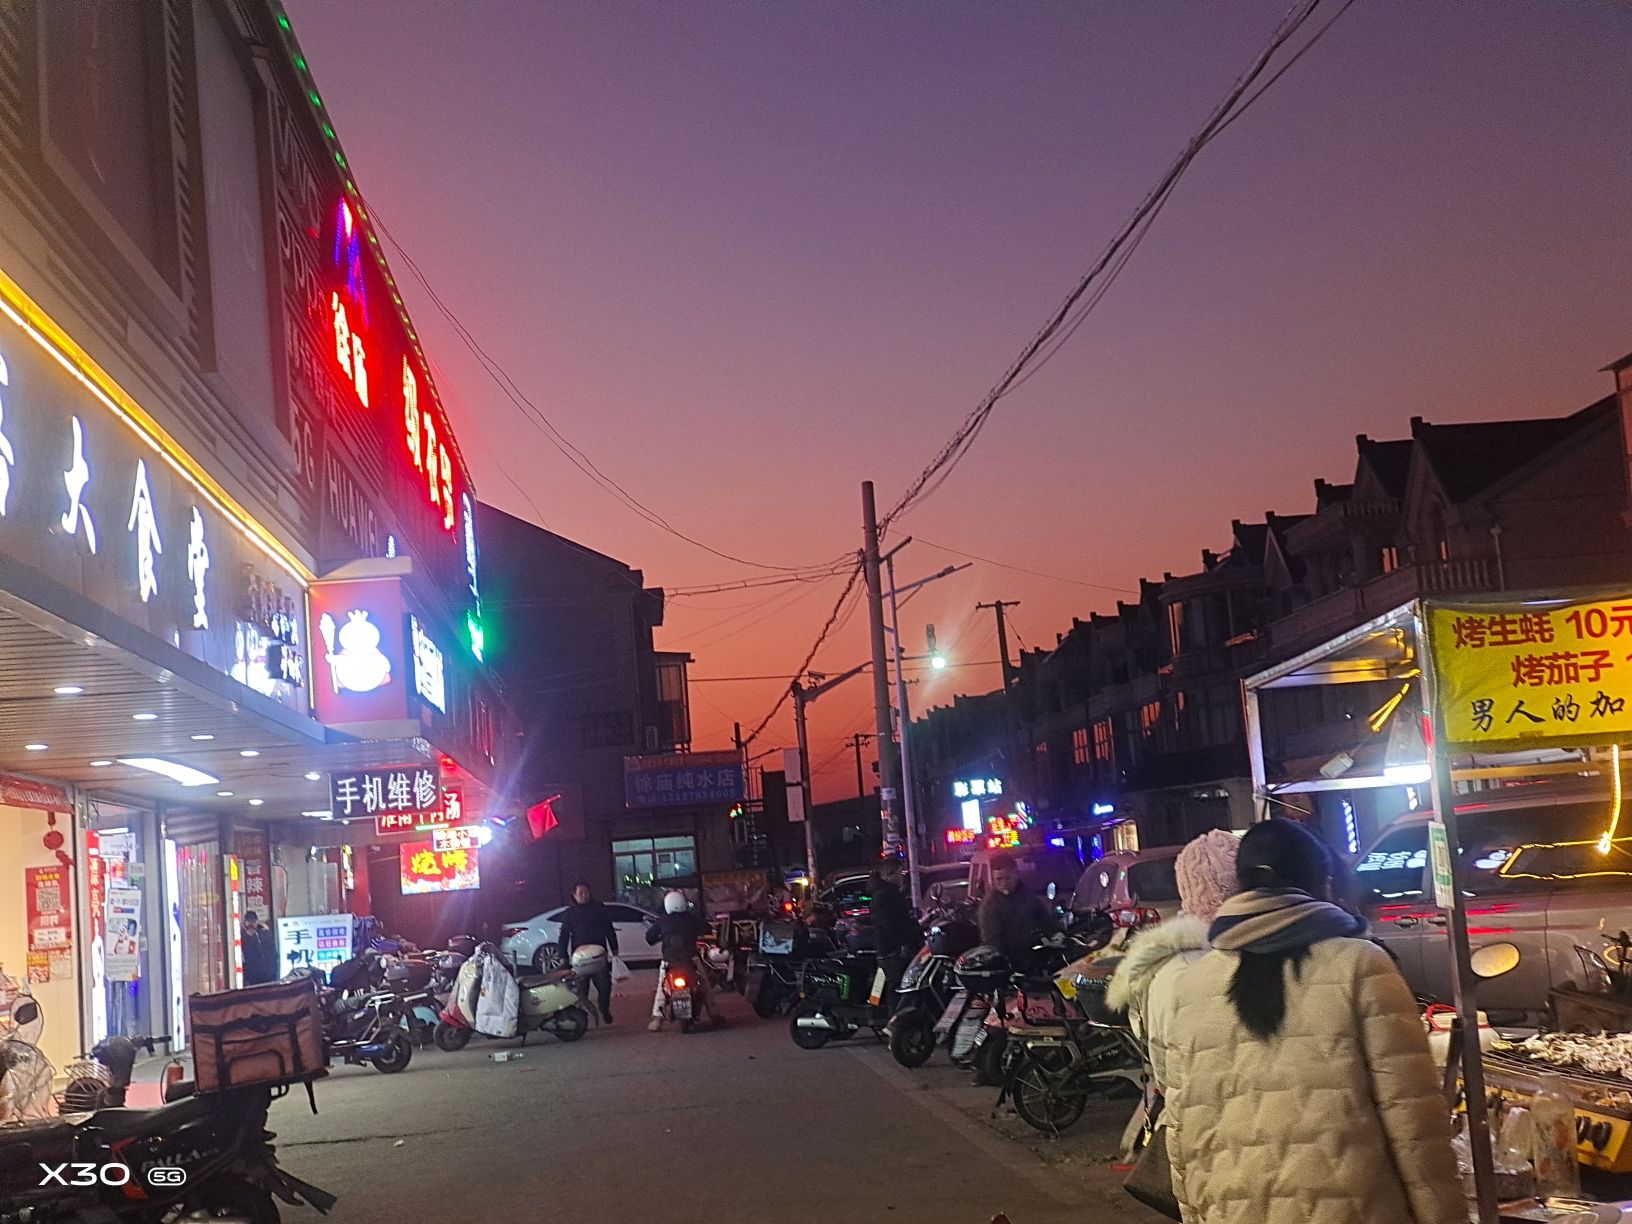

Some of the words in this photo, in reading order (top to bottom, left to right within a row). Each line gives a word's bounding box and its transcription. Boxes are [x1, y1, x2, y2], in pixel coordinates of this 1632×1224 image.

[326, 449, 379, 558] HUAWEI
[1452, 612, 1555, 650] 烤生蚝
[1511, 650, 1614, 688] 烤茄子
[335, 769, 437, 815] 手机维修
